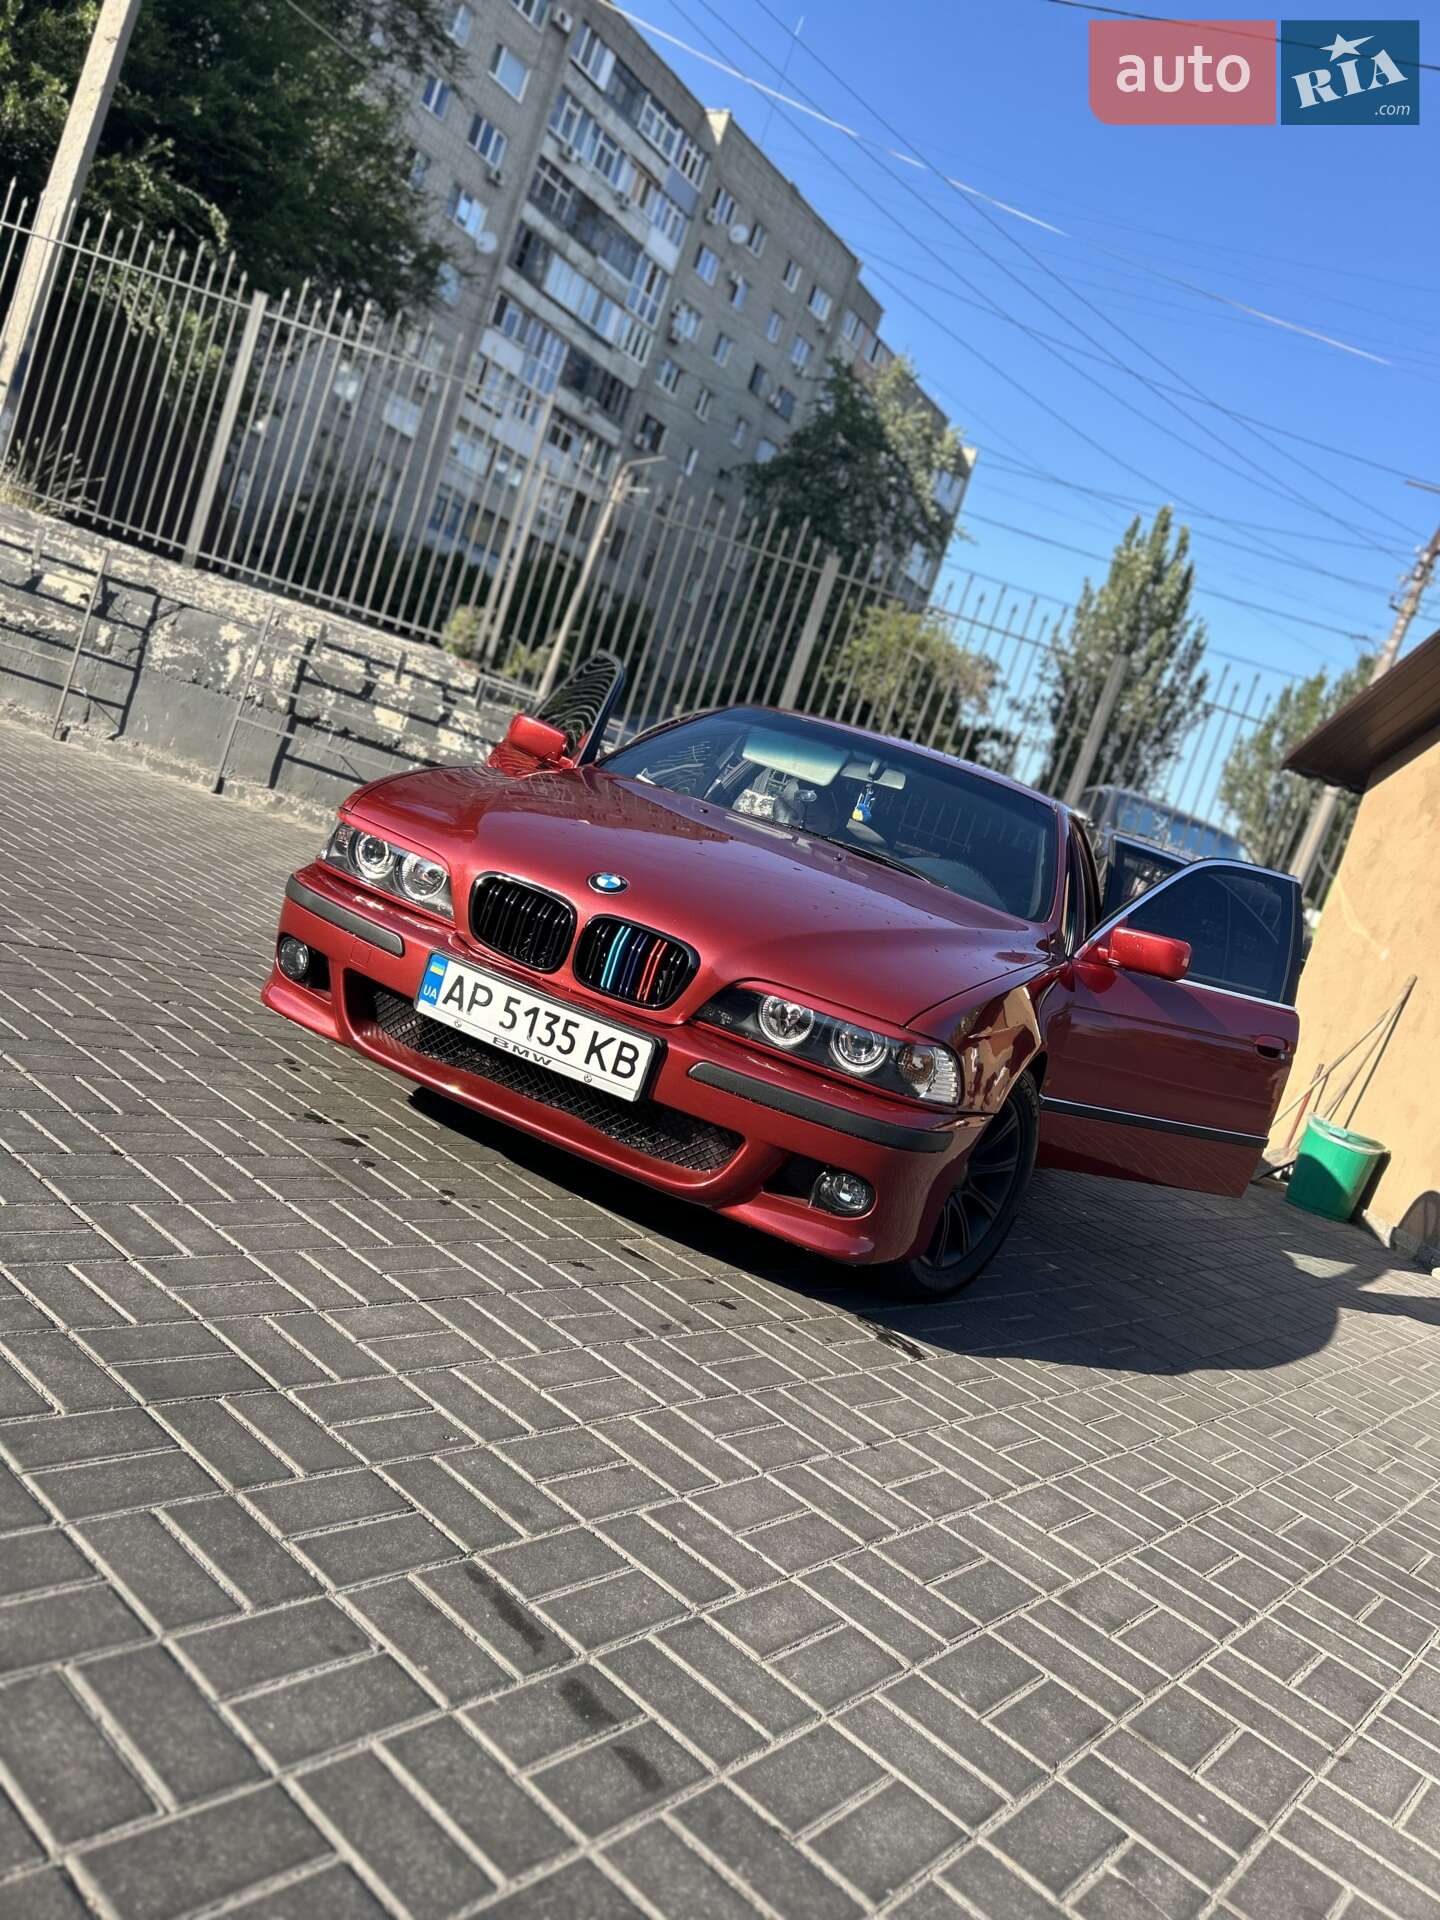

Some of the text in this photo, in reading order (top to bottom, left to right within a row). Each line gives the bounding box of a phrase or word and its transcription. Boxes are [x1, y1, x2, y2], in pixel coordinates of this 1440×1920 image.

[423, 985, 438, 999] UA
[442, 975, 639, 1079] AP 5135 KB
[492, 1036, 552, 1066] BMW
